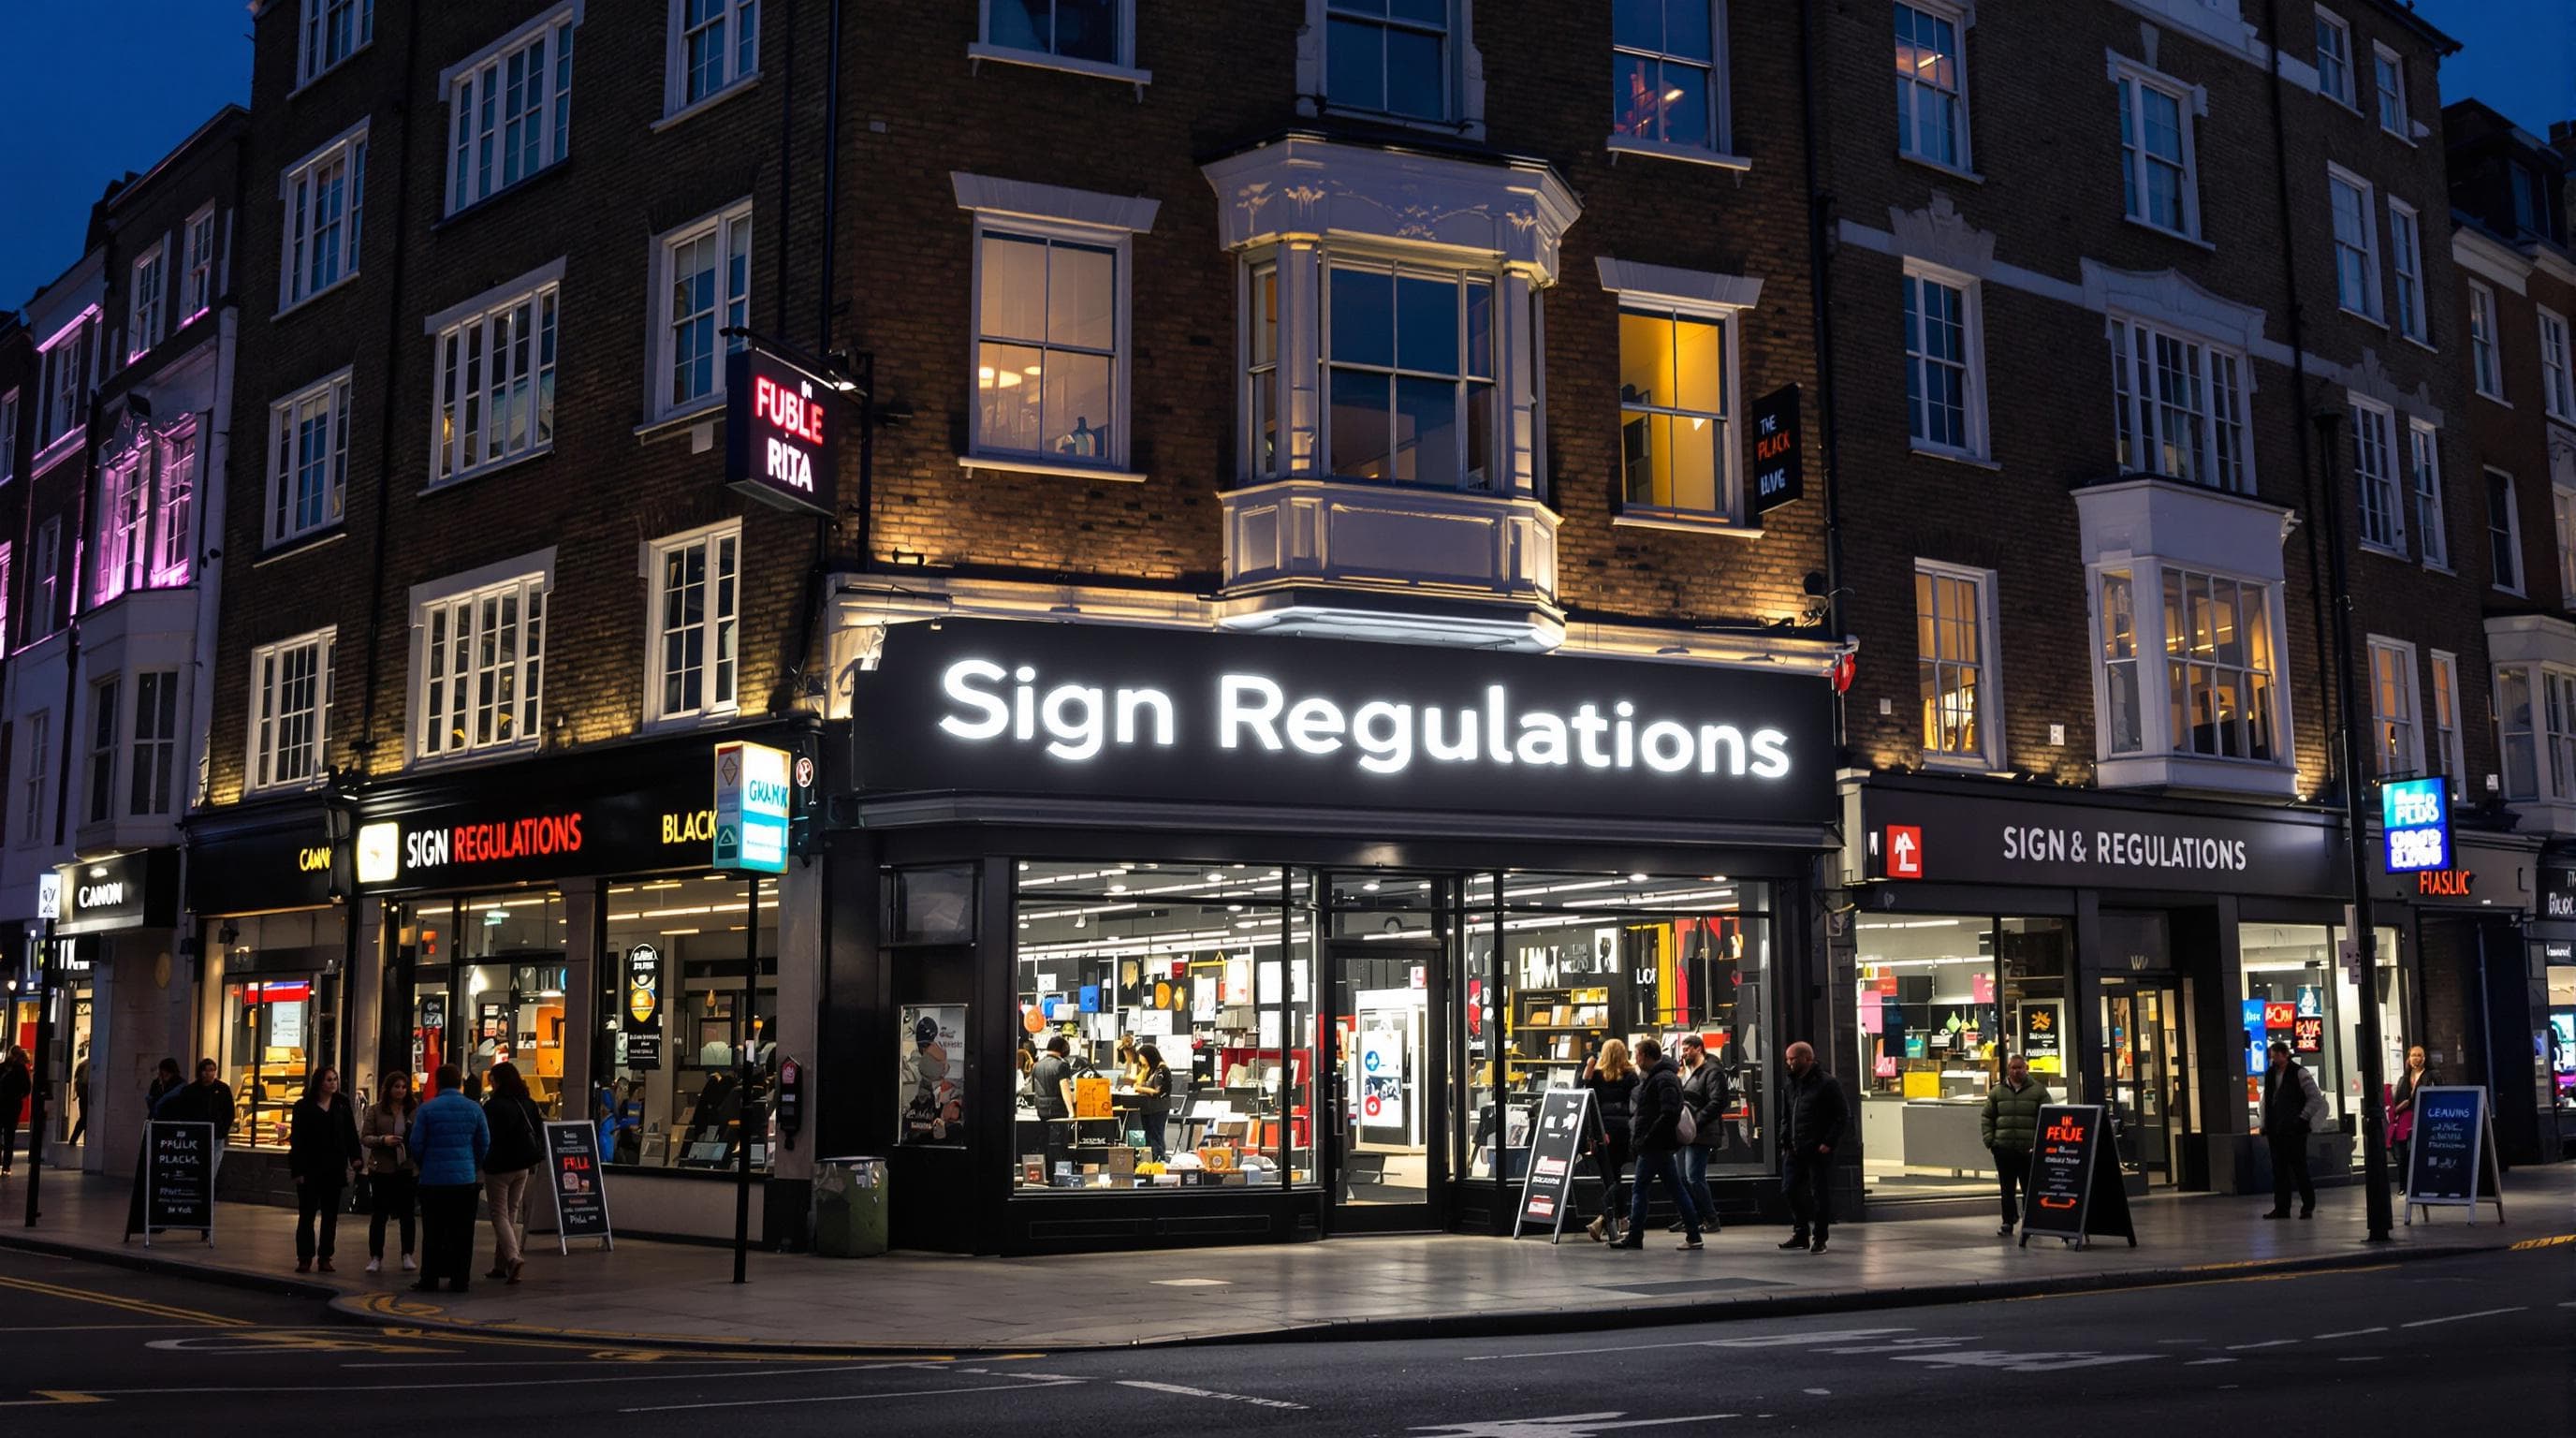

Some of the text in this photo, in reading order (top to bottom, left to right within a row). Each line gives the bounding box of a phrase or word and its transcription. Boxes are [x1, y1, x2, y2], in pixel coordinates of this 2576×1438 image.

[754, 376, 825, 446] FUBLE
[767, 436, 813, 492] RITA
[938, 659, 1792, 779] Sign Regulations
[406, 813, 582, 869] SIGN REGULATIONS
[662, 809, 719, 844] BLACK
[2003, 826, 2247, 871] SIGN & REGULATIONS
[79, 882, 124, 908] CANON
